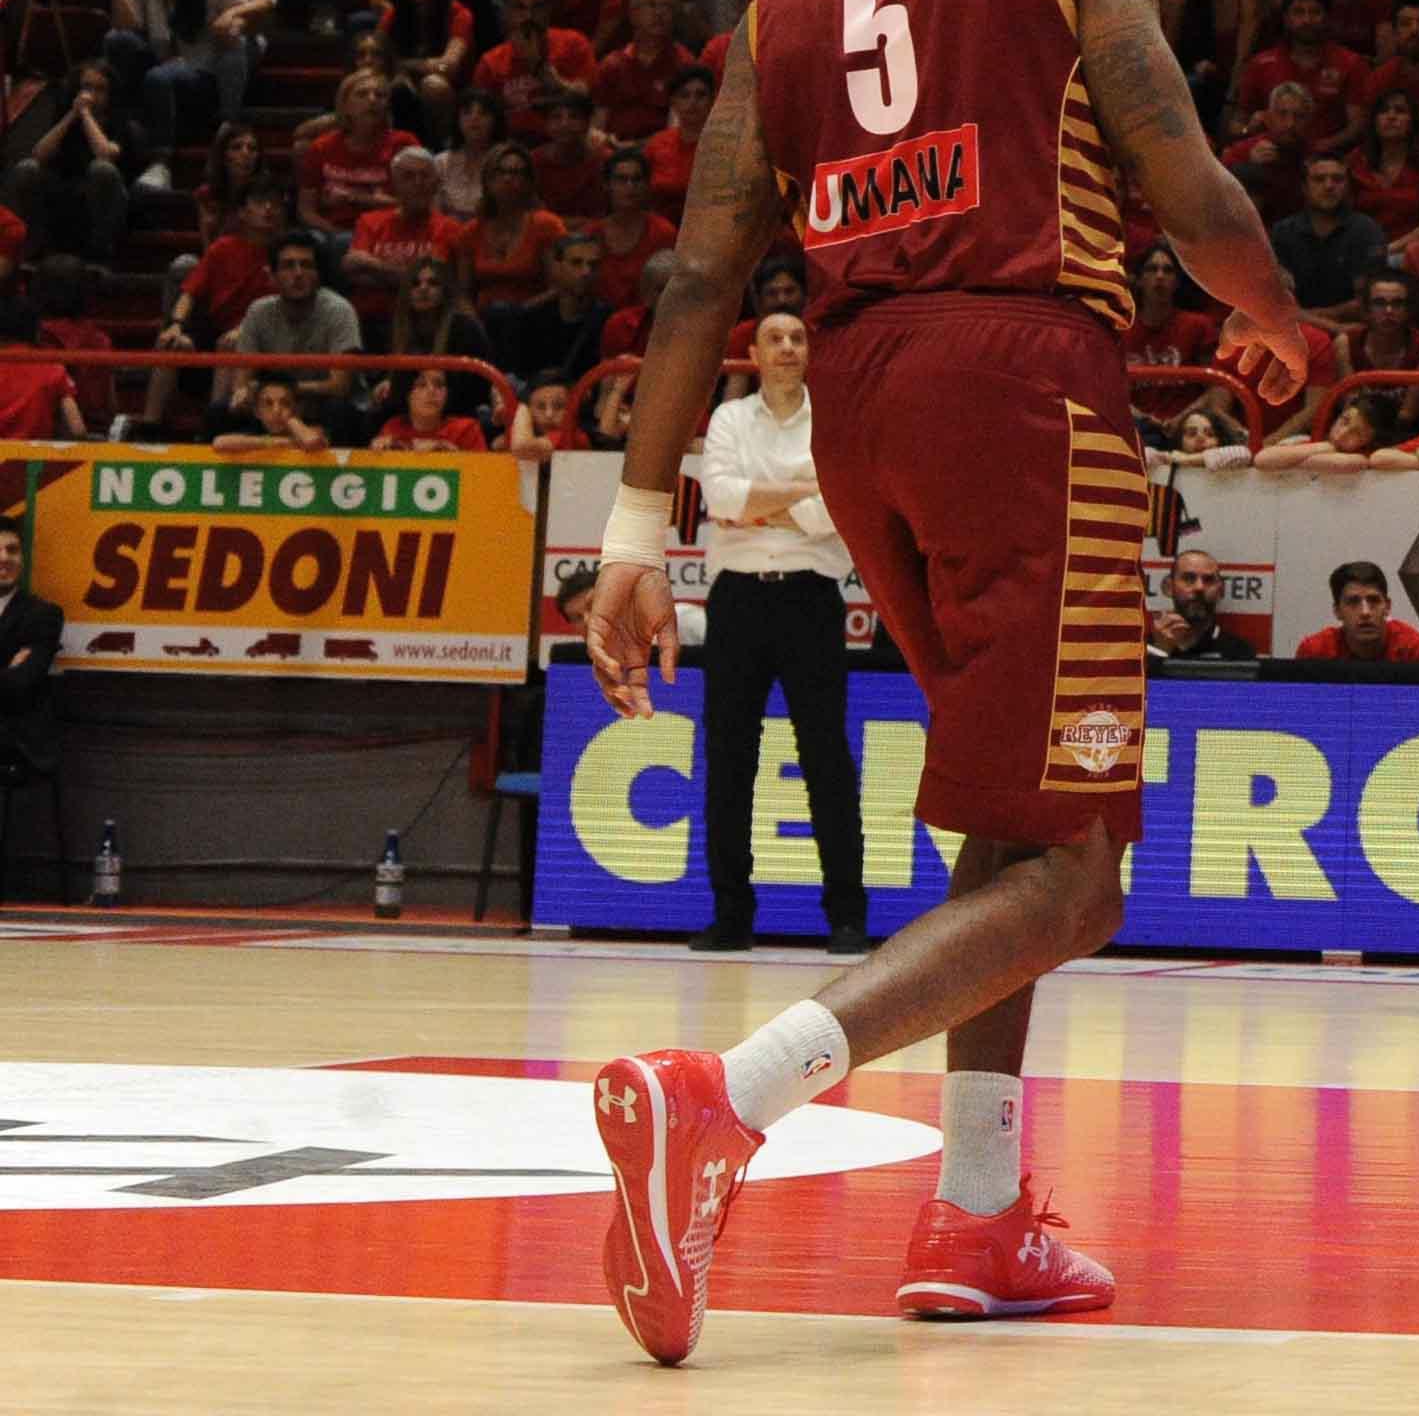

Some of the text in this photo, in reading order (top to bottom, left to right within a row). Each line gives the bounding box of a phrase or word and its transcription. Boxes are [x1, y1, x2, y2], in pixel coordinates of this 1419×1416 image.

[97, 466, 454, 515] NOLEGGIO
[82, 522, 457, 619] SEDONI
[392, 639, 513, 662] www.sedoni.it
[1060, 724, 1132, 745] REYER
